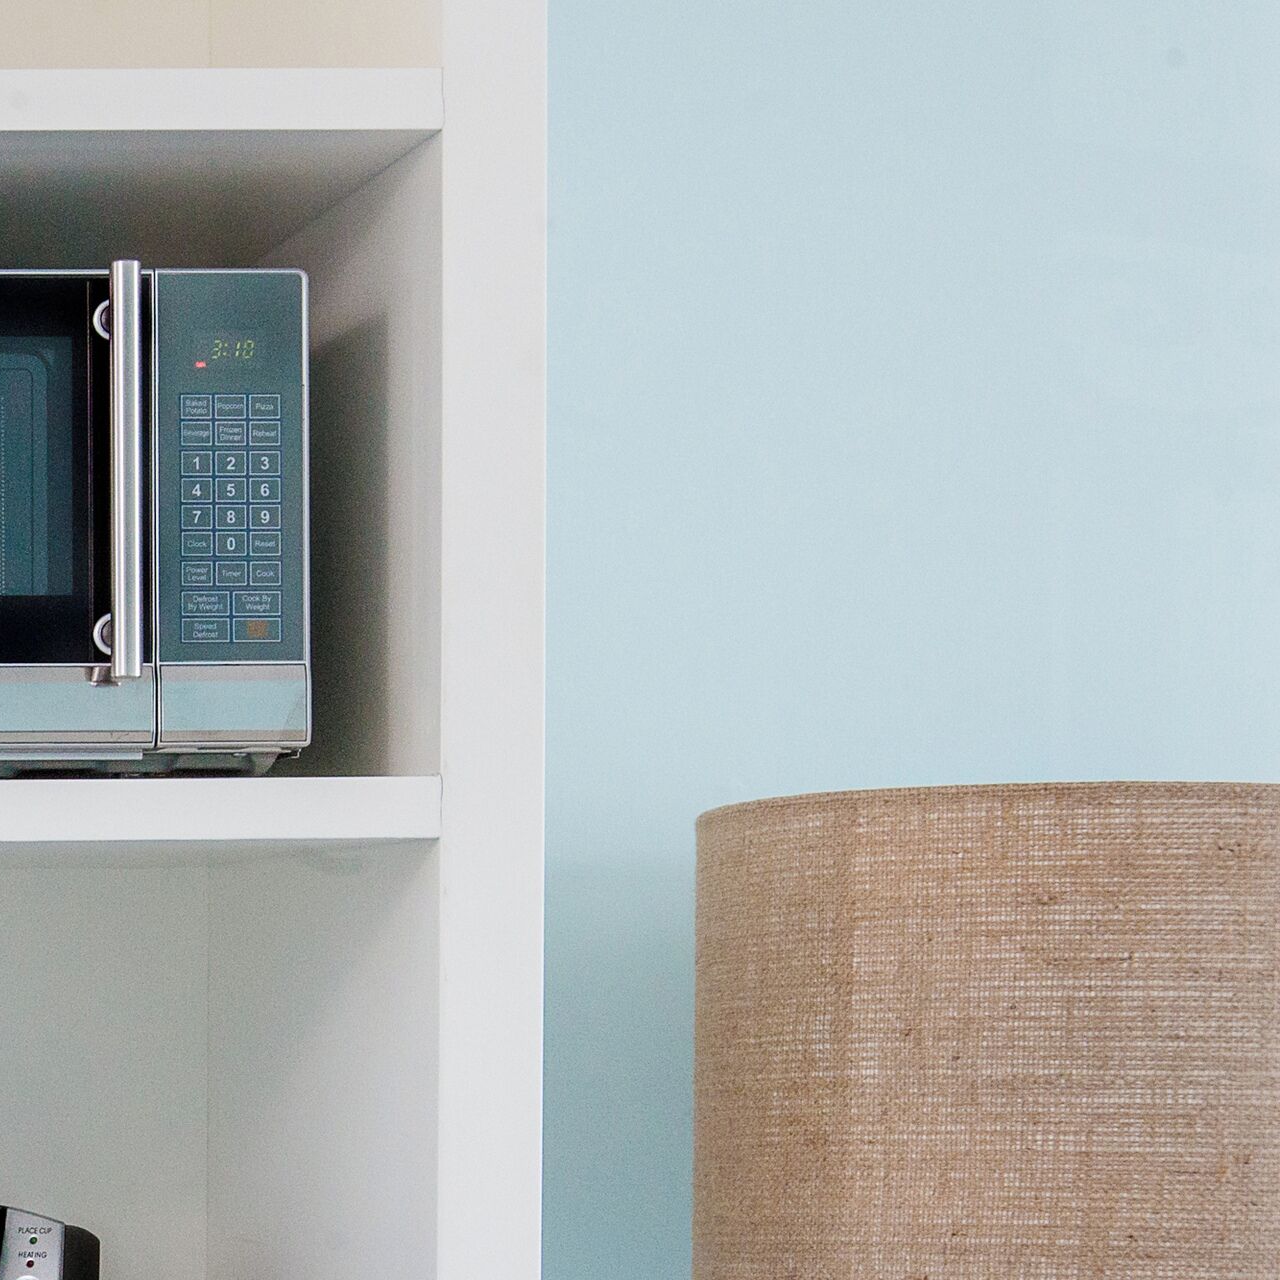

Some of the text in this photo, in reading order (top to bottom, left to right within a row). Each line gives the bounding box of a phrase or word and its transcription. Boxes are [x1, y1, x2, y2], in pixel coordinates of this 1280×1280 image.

[212, 340, 254, 359] 3:10
[218, 403, 244, 411] Popcorn
[193, 456, 199, 470] 1
[226, 457, 235, 470] 2
[260, 457, 269, 470] 3
[192, 484, 201, 497] 4
[226, 484, 235, 497] 5
[260, 484, 269, 497] 6
[192, 511, 201, 523] 7
[226, 511, 235, 523] 8
[260, 511, 269, 523] 9
[226, 537, 235, 550] 0
[192, 595, 218, 603] Defrost
[262, 595, 271, 603] By
[199, 603, 223, 611] Weight
[246, 603, 270, 611] Weight
[194, 623, 217, 631] Speed
[192, 631, 218, 639] Defrost
